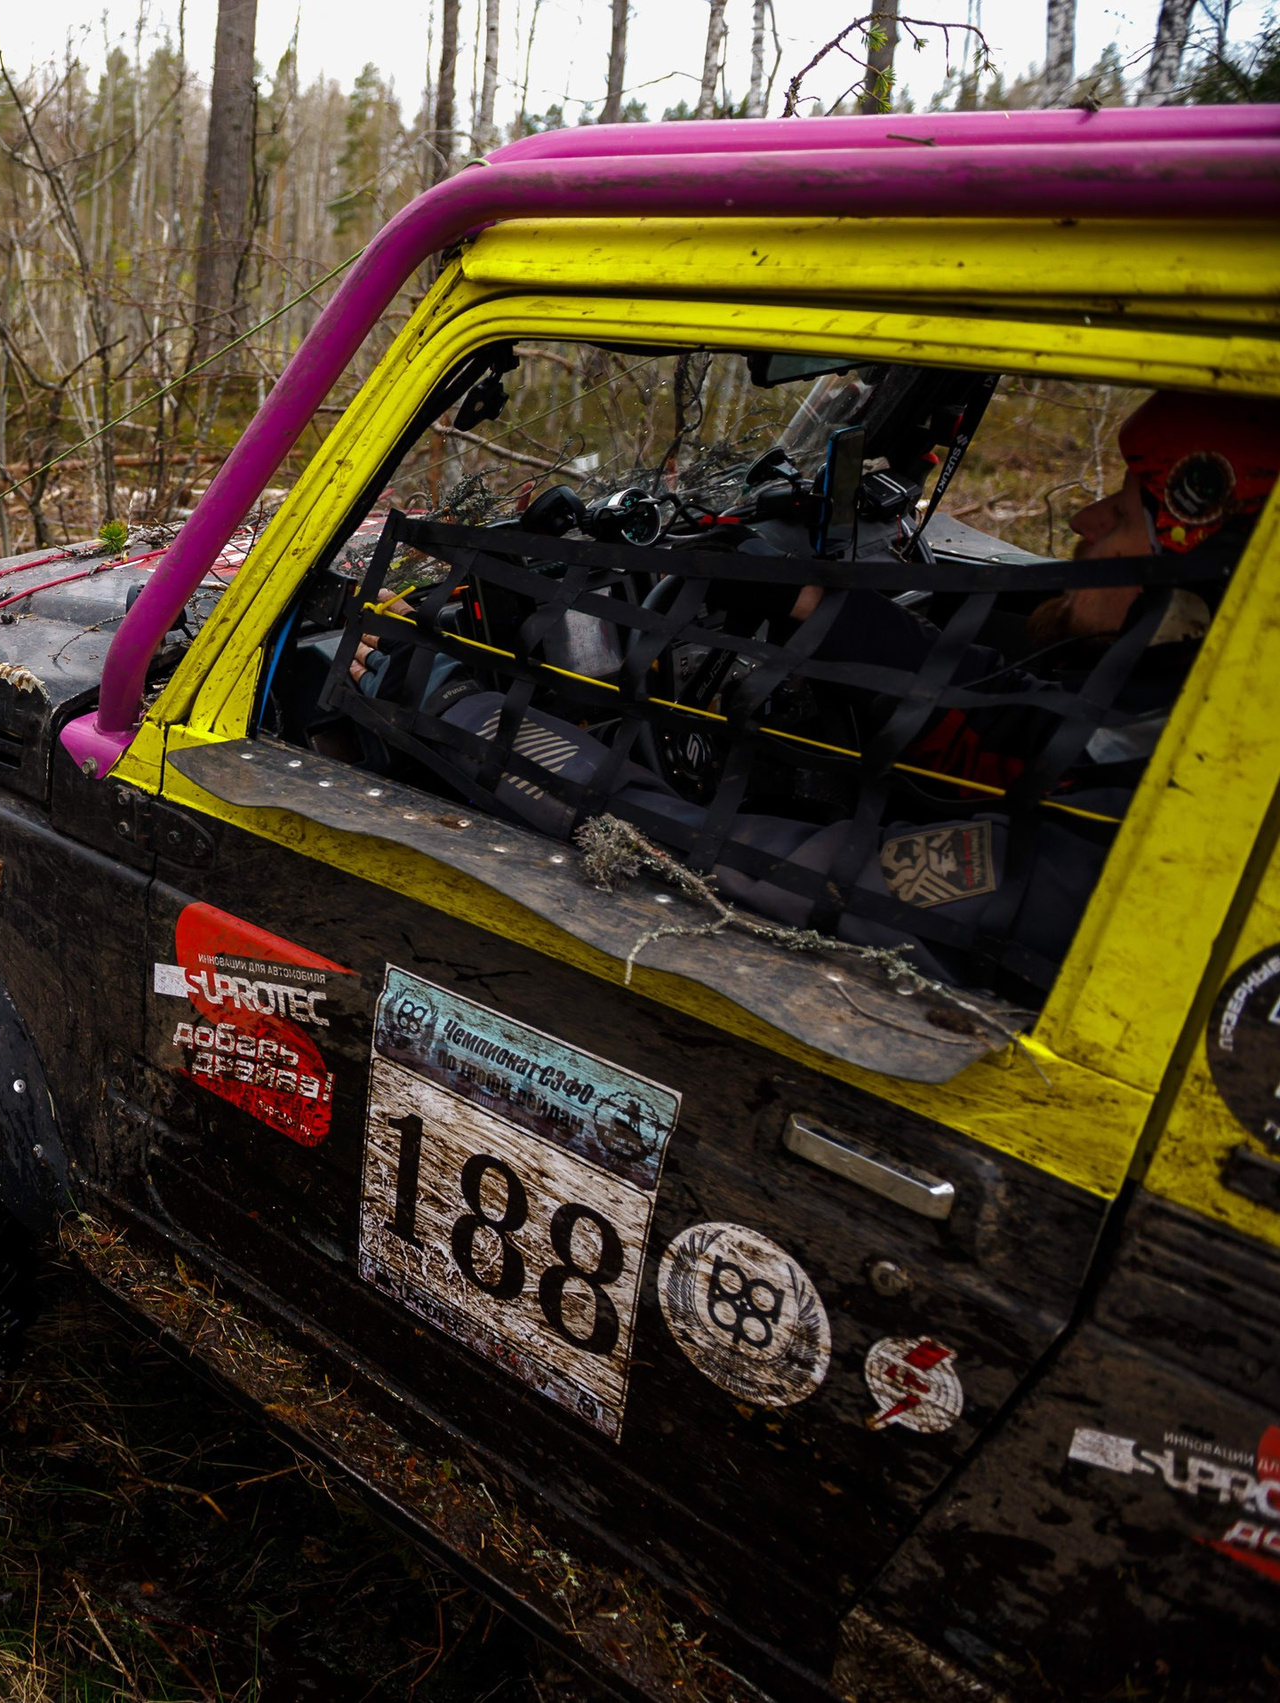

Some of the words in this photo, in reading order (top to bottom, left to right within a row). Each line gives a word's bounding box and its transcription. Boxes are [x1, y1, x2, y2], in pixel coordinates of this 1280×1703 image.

[936, 447, 962, 494] SUZUKI
[198, 953, 248, 971] ИННОВАЦИИ
[248, 961, 266, 974] ДЛЯ
[267, 965, 327, 984] АВТОМОБИЛЯ
[184, 969, 330, 1027] SUPROTEC
[442, 1018, 540, 1080] Чемпионат
[383, 1113, 625, 1356] 188
[1163, 1431, 1256, 1467] ИННОВАЦИИ
